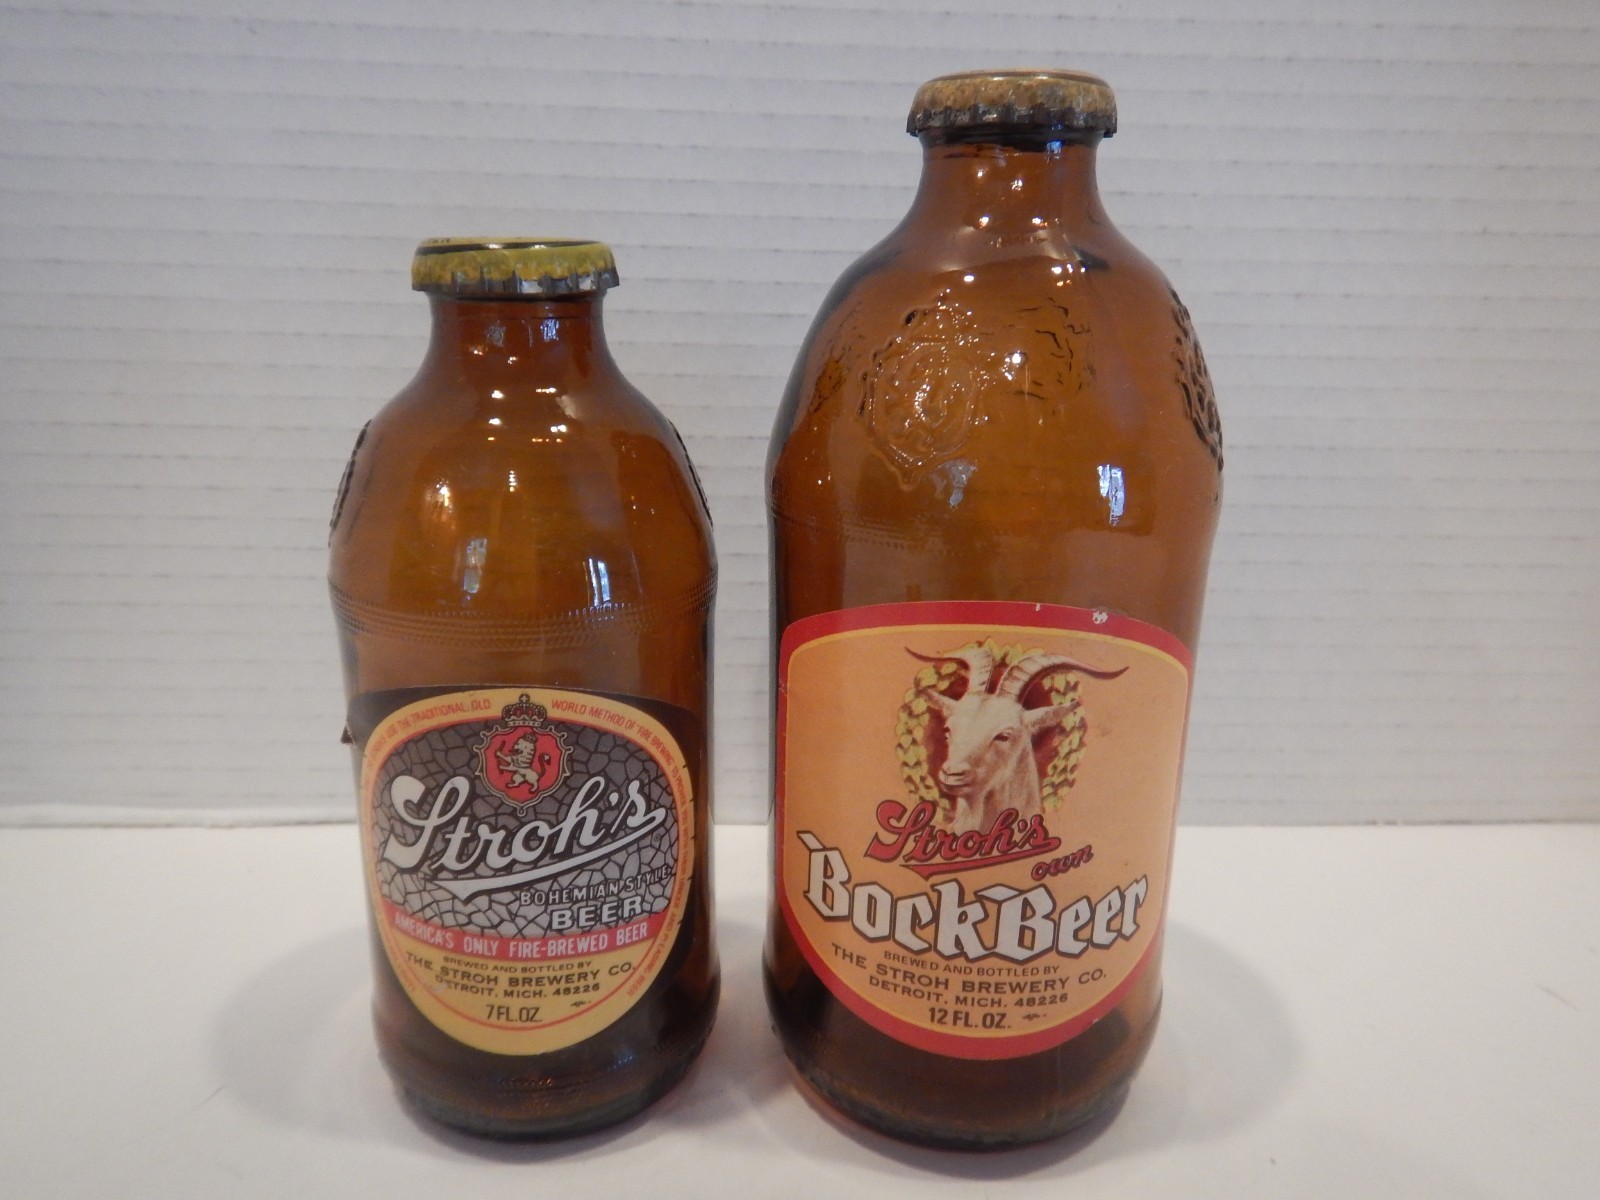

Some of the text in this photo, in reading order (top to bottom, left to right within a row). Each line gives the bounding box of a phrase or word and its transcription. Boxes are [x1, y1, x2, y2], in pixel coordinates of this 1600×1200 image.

[471, 698, 491, 710] OLD
[551, 699, 586, 715] WORLD
[588, 707, 625, 727] METHOD
[625, 719, 636, 730] OF
[382, 774, 667, 873] Stroh's
[863, 799, 1062, 864] Stroh's
[1031, 844, 1094, 881] own
[519, 880, 620, 905] BOHEMIAN
[551, 895, 643, 932] BEER
[394, 911, 648, 958] AMERICA'S ONLY FIRE-BREWED BEER
[405, 951, 636, 988] THE STROH BREWERY CO.
[443, 955, 593, 974] BREWED AND BOTTLED BY
[831, 942, 1107, 994] THE STROH BREWERY CO.
[884, 950, 1060, 977] BREWED AND BOTTLED BY
[503, 989, 548, 999] MICH.
[552, 983, 601, 997] 48226
[954, 995, 1008, 1008] MICH.
[1014, 993, 1069, 1007] 48226
[928, 1007, 949, 1025] 12
